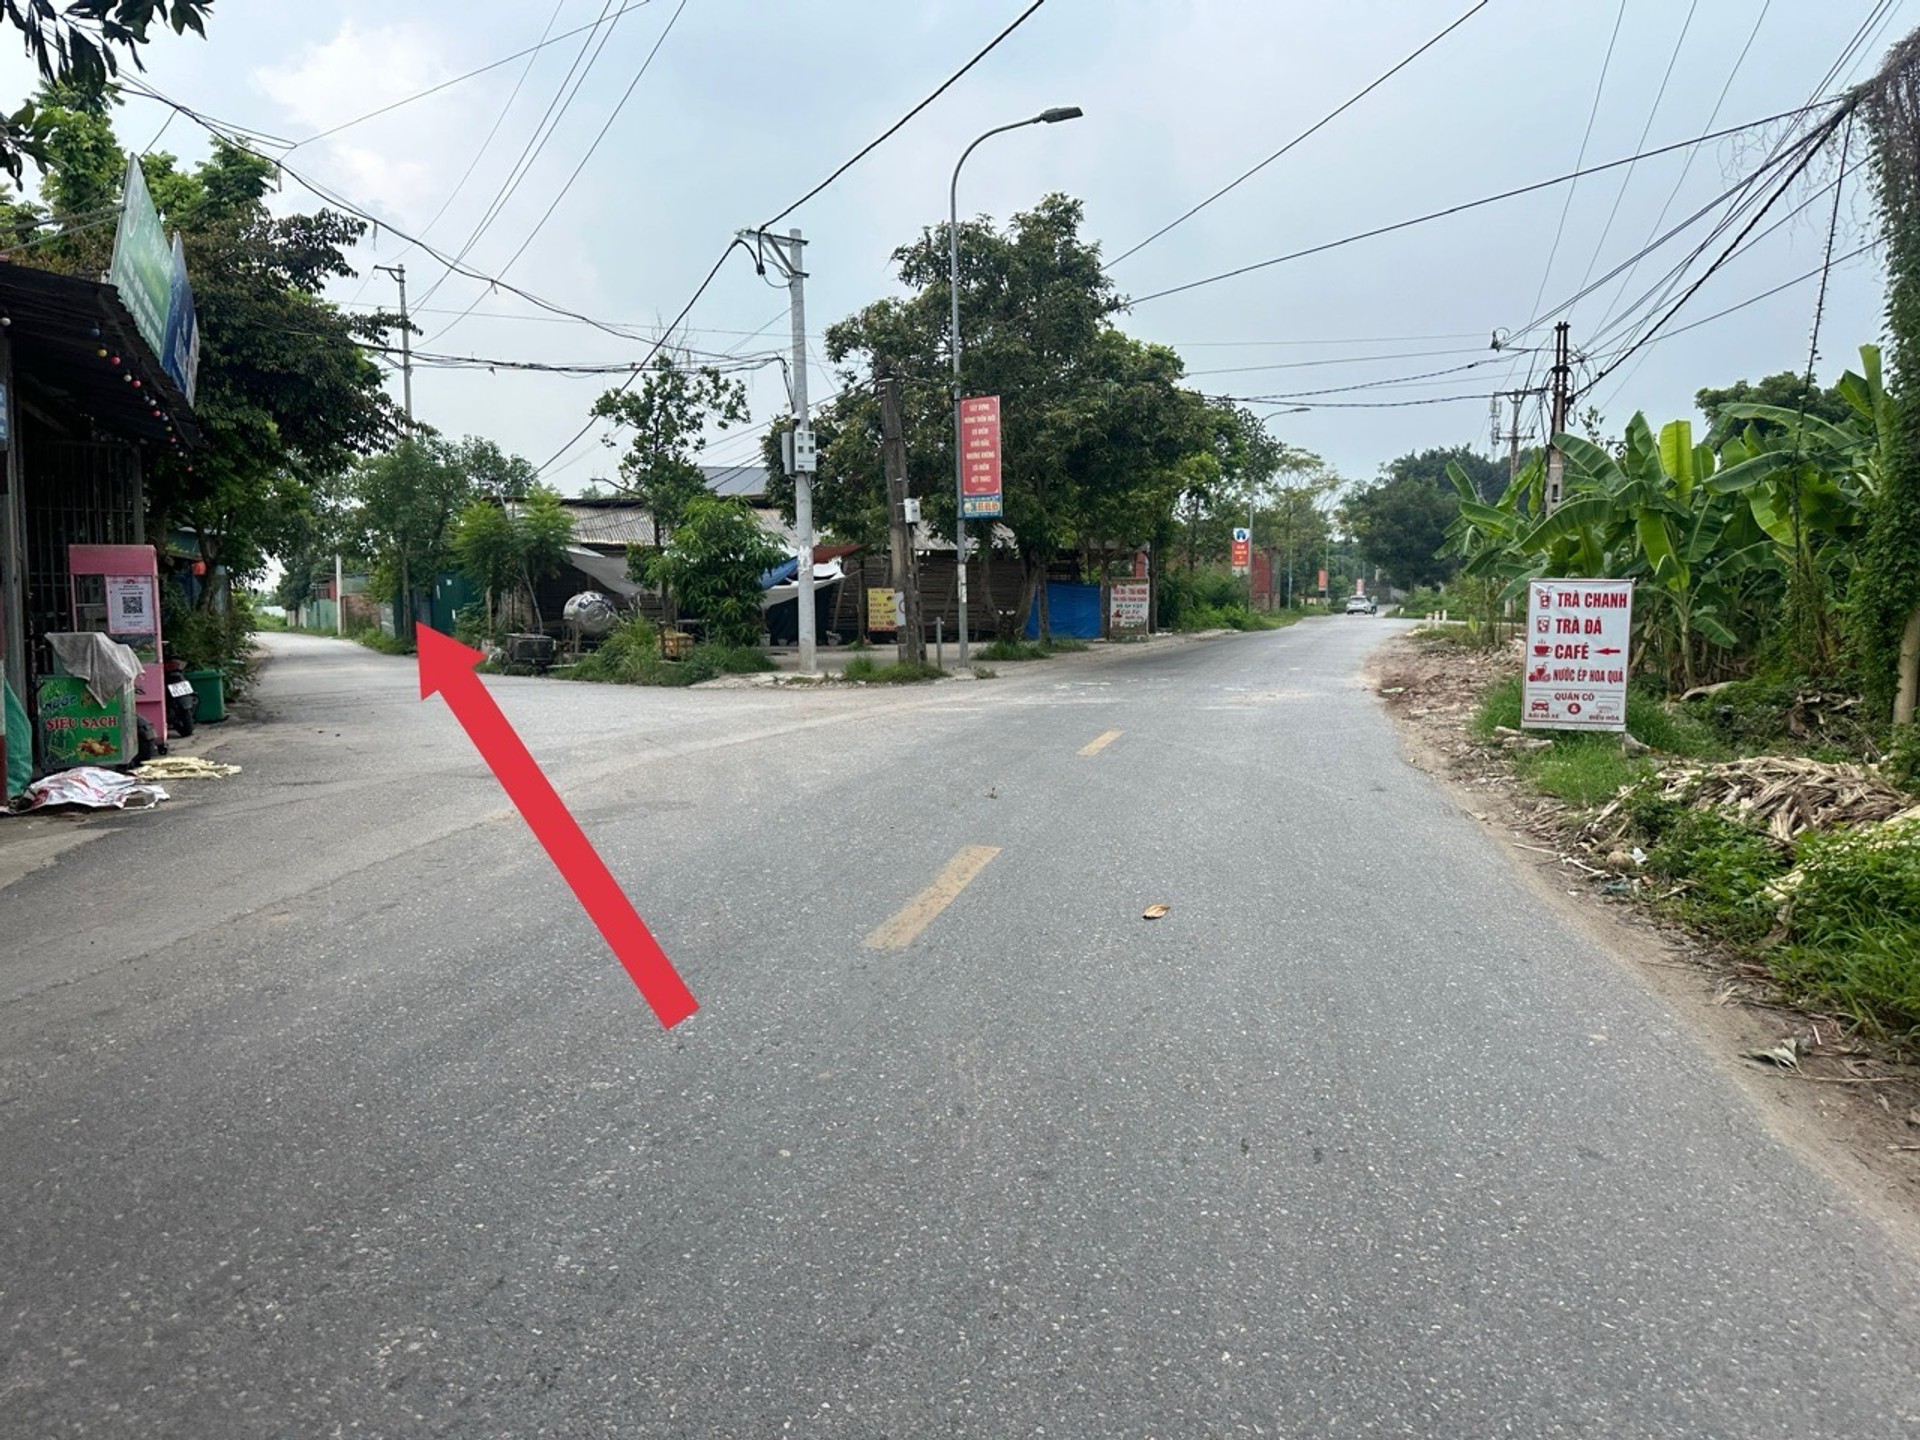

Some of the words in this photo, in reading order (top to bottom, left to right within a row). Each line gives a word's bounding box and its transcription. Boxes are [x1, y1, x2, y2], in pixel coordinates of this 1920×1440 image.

[1557, 590, 1580, 608] TRÀ
[1584, 593, 1627, 608] CHANH
[1556, 616, 1580, 634] TRÀ
[1584, 616, 1602, 635] ĐÁ
[1555, 642, 1589, 659] CAFÉ
[1552, 666, 1575, 682] NƯỚC
[1577, 667, 1588, 682] ÉP
[1589, 669, 1605, 682] HOA
[1607, 667, 1623, 684] QUẢ
[1581, 691, 1595, 701] CÓ
